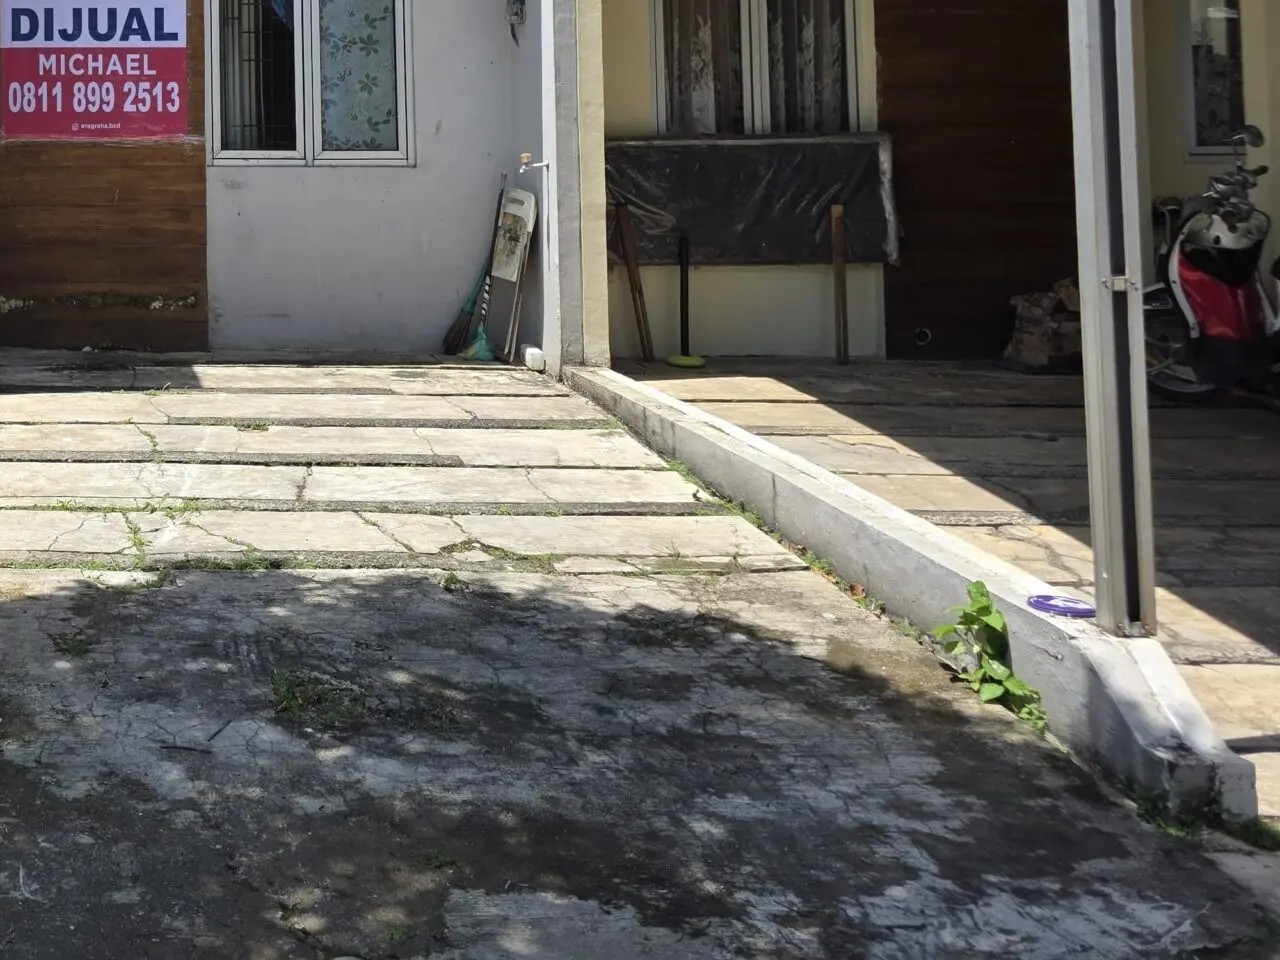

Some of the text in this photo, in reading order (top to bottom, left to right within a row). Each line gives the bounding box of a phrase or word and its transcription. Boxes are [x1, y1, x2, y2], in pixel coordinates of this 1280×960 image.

[11, 7, 179, 42] DIJUAL
[38, 54, 157, 76] MICHAEL
[8, 81, 180, 113] 0811 899 2513
